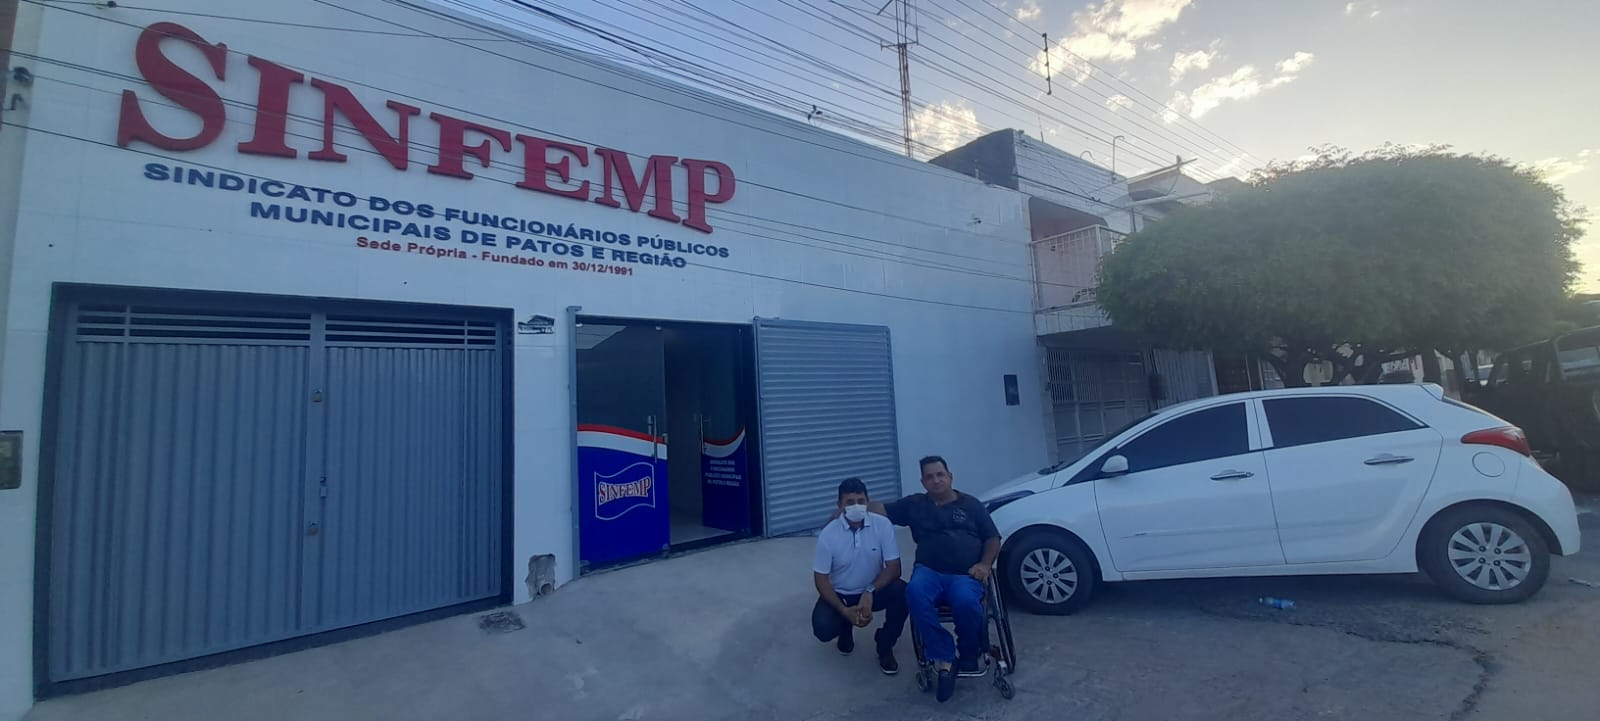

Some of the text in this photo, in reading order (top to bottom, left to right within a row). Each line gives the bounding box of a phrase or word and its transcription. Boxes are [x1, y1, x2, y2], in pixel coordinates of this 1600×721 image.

[117, 22, 735, 233] SINFEMP
[143, 163, 730, 258] SINDICATO DOS FUNCIONÁRIOS PÚBLICOS
[250, 202, 687, 269] MUNICIPAIS DE PATOS E REGIÃO
[356, 236, 401, 252] Sede
[407, 242, 467, 260] Própria
[481, 251, 545, 267] Fundado
[548, 260, 568, 270] em
[572, 260, 633, 276] 30/12/1991
[599, 476, 651, 506] SINFEMP
